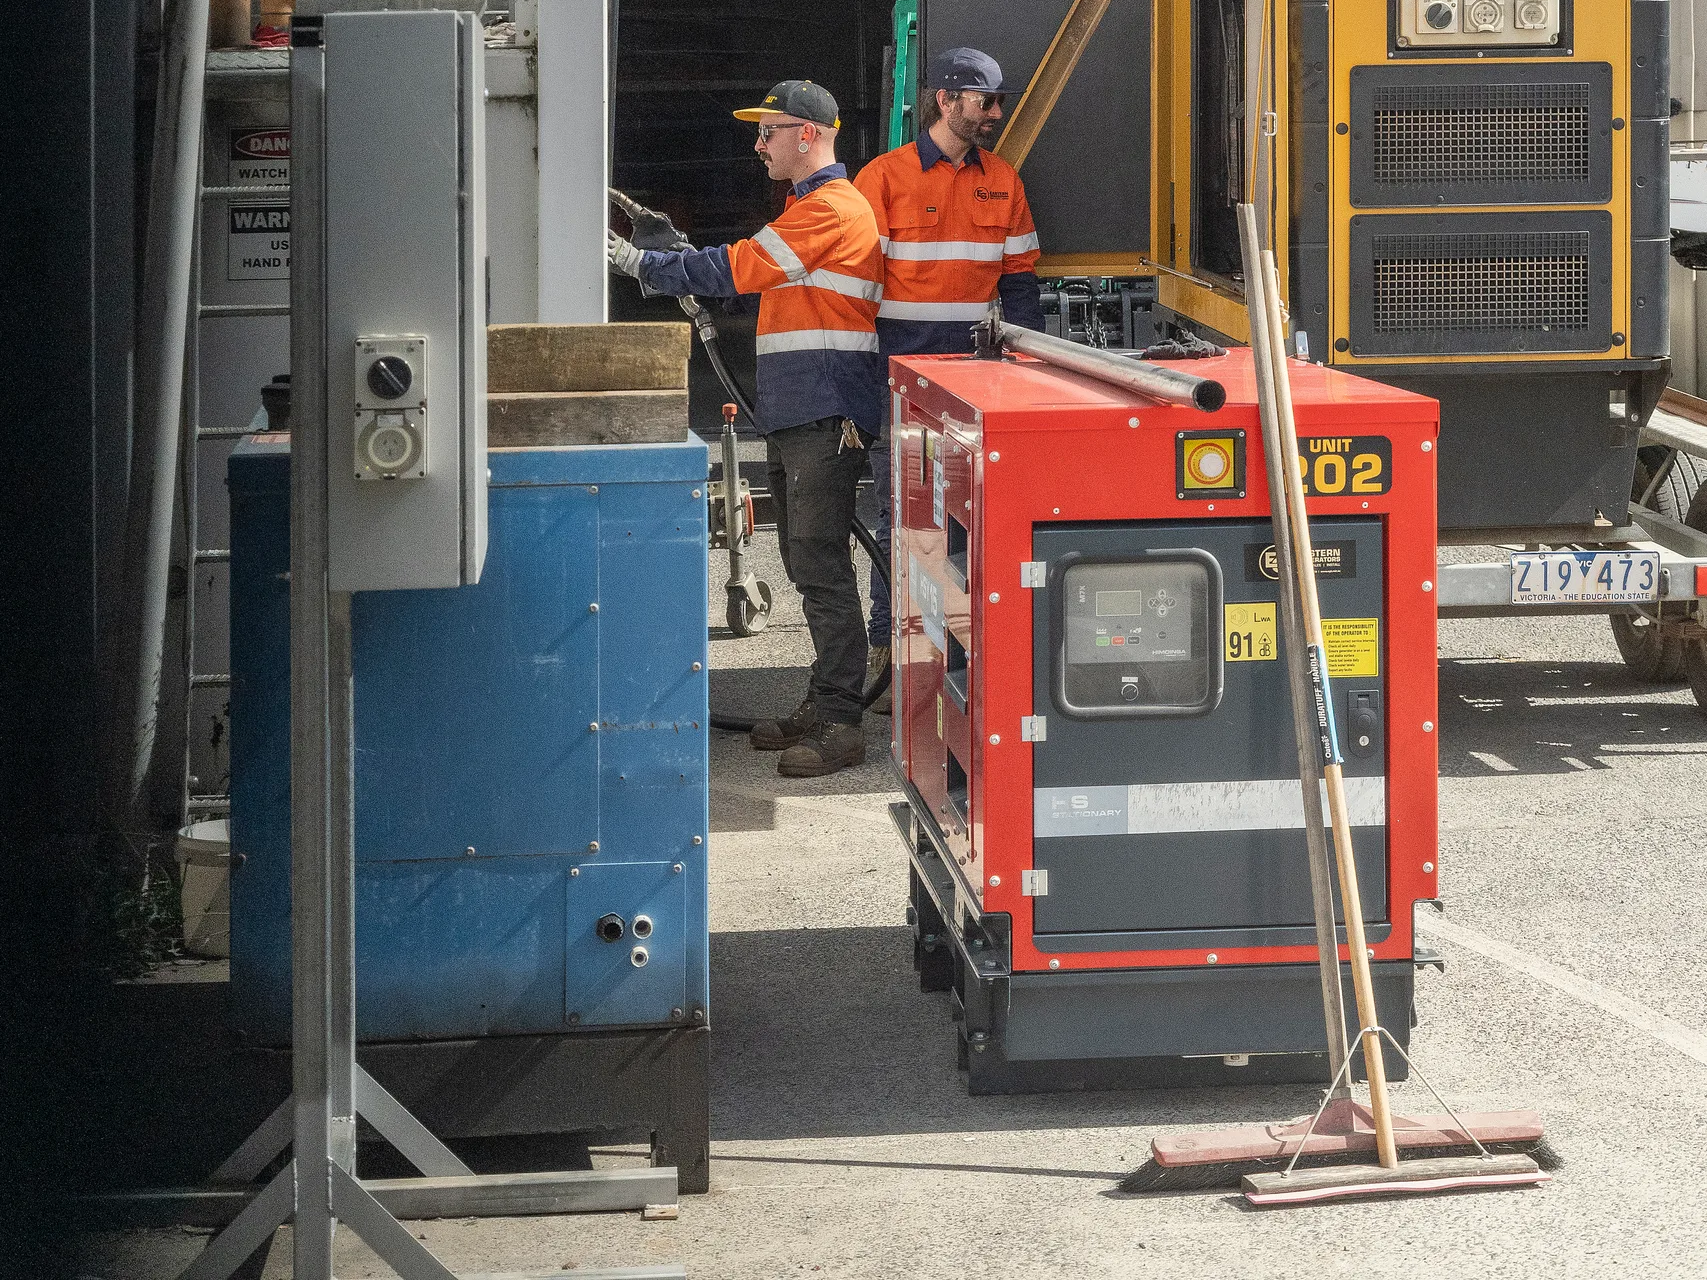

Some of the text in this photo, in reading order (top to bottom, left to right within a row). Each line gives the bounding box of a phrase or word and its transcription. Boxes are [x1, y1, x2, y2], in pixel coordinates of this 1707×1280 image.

[238, 168, 287, 179] WATCH
[242, 258, 281, 268] HAND
[1309, 438, 1353, 453] UNIT
[1310, 548, 1341, 557] STERN
[1517, 559, 1654, 592] Z19 473
[1519, 593, 1556, 601] VICTORIA
[1626, 592, 1650, 600] STATE
[1229, 631, 1253, 658] 91
[1259, 644, 1271, 657] dB
[1309, 651, 1323, 683] HANDLE
[1314, 688, 1328, 727] DURATUFF
